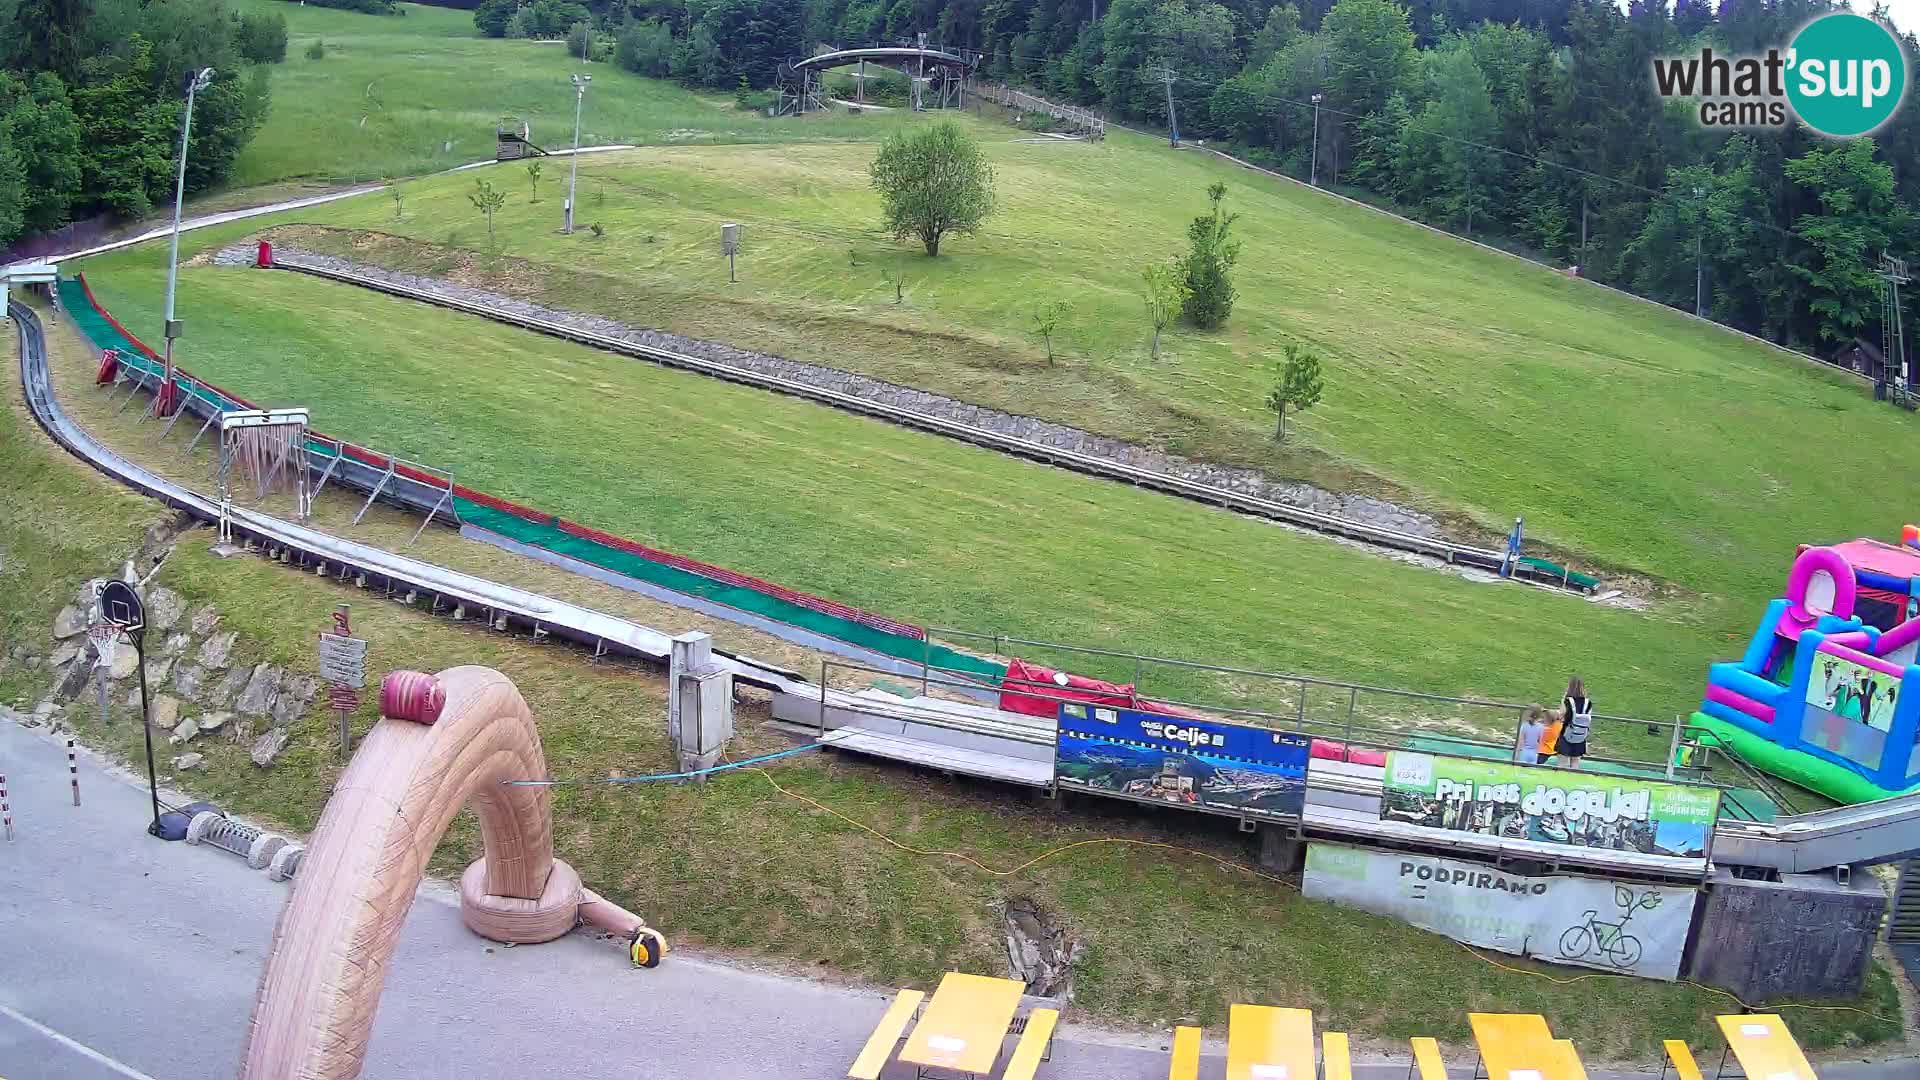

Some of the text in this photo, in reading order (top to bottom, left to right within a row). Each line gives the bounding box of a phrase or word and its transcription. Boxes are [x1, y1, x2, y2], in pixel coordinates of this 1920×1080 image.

[1164, 725, 1209, 746] Celje
[1436, 778, 1473, 801] Pri
[1478, 783, 1520, 803] nas
[1522, 784, 1650, 822] dogaja!
[1400, 862, 1547, 895] PODPIRAMO
